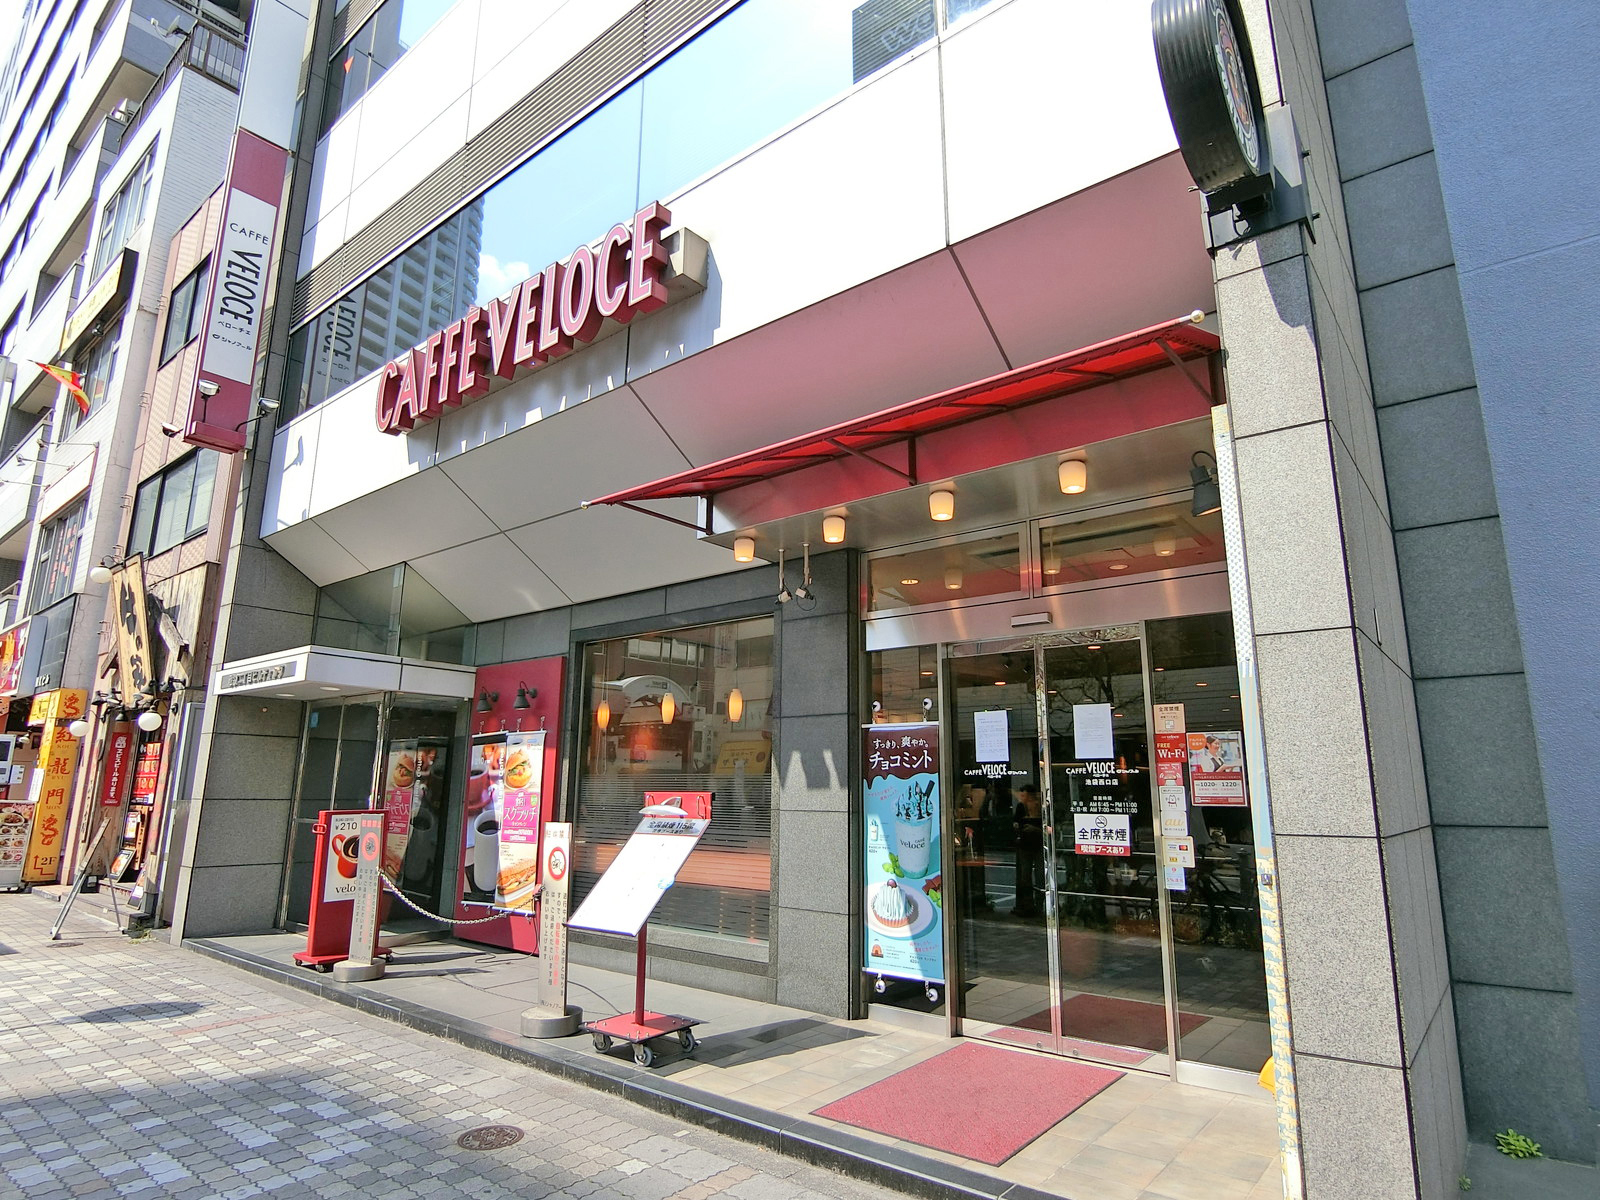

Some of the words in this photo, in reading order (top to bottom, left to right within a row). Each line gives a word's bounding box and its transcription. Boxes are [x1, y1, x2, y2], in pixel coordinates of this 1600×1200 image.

[220, 250, 263, 326] VELOCE
[488, 200, 671, 380] VELOCE
[873, 736, 929, 749] すっきり、爽やか。
[869, 749, 932, 770] チョコミント
[981, 764, 1007, 775] VELOCE
[1085, 762, 1115, 774] VELOCE
[1077, 827, 1127, 841] 全席禁煙
[1080, 845, 1125, 854] 喫煙ブースあり
[41, 856, 57, 866] 2F
